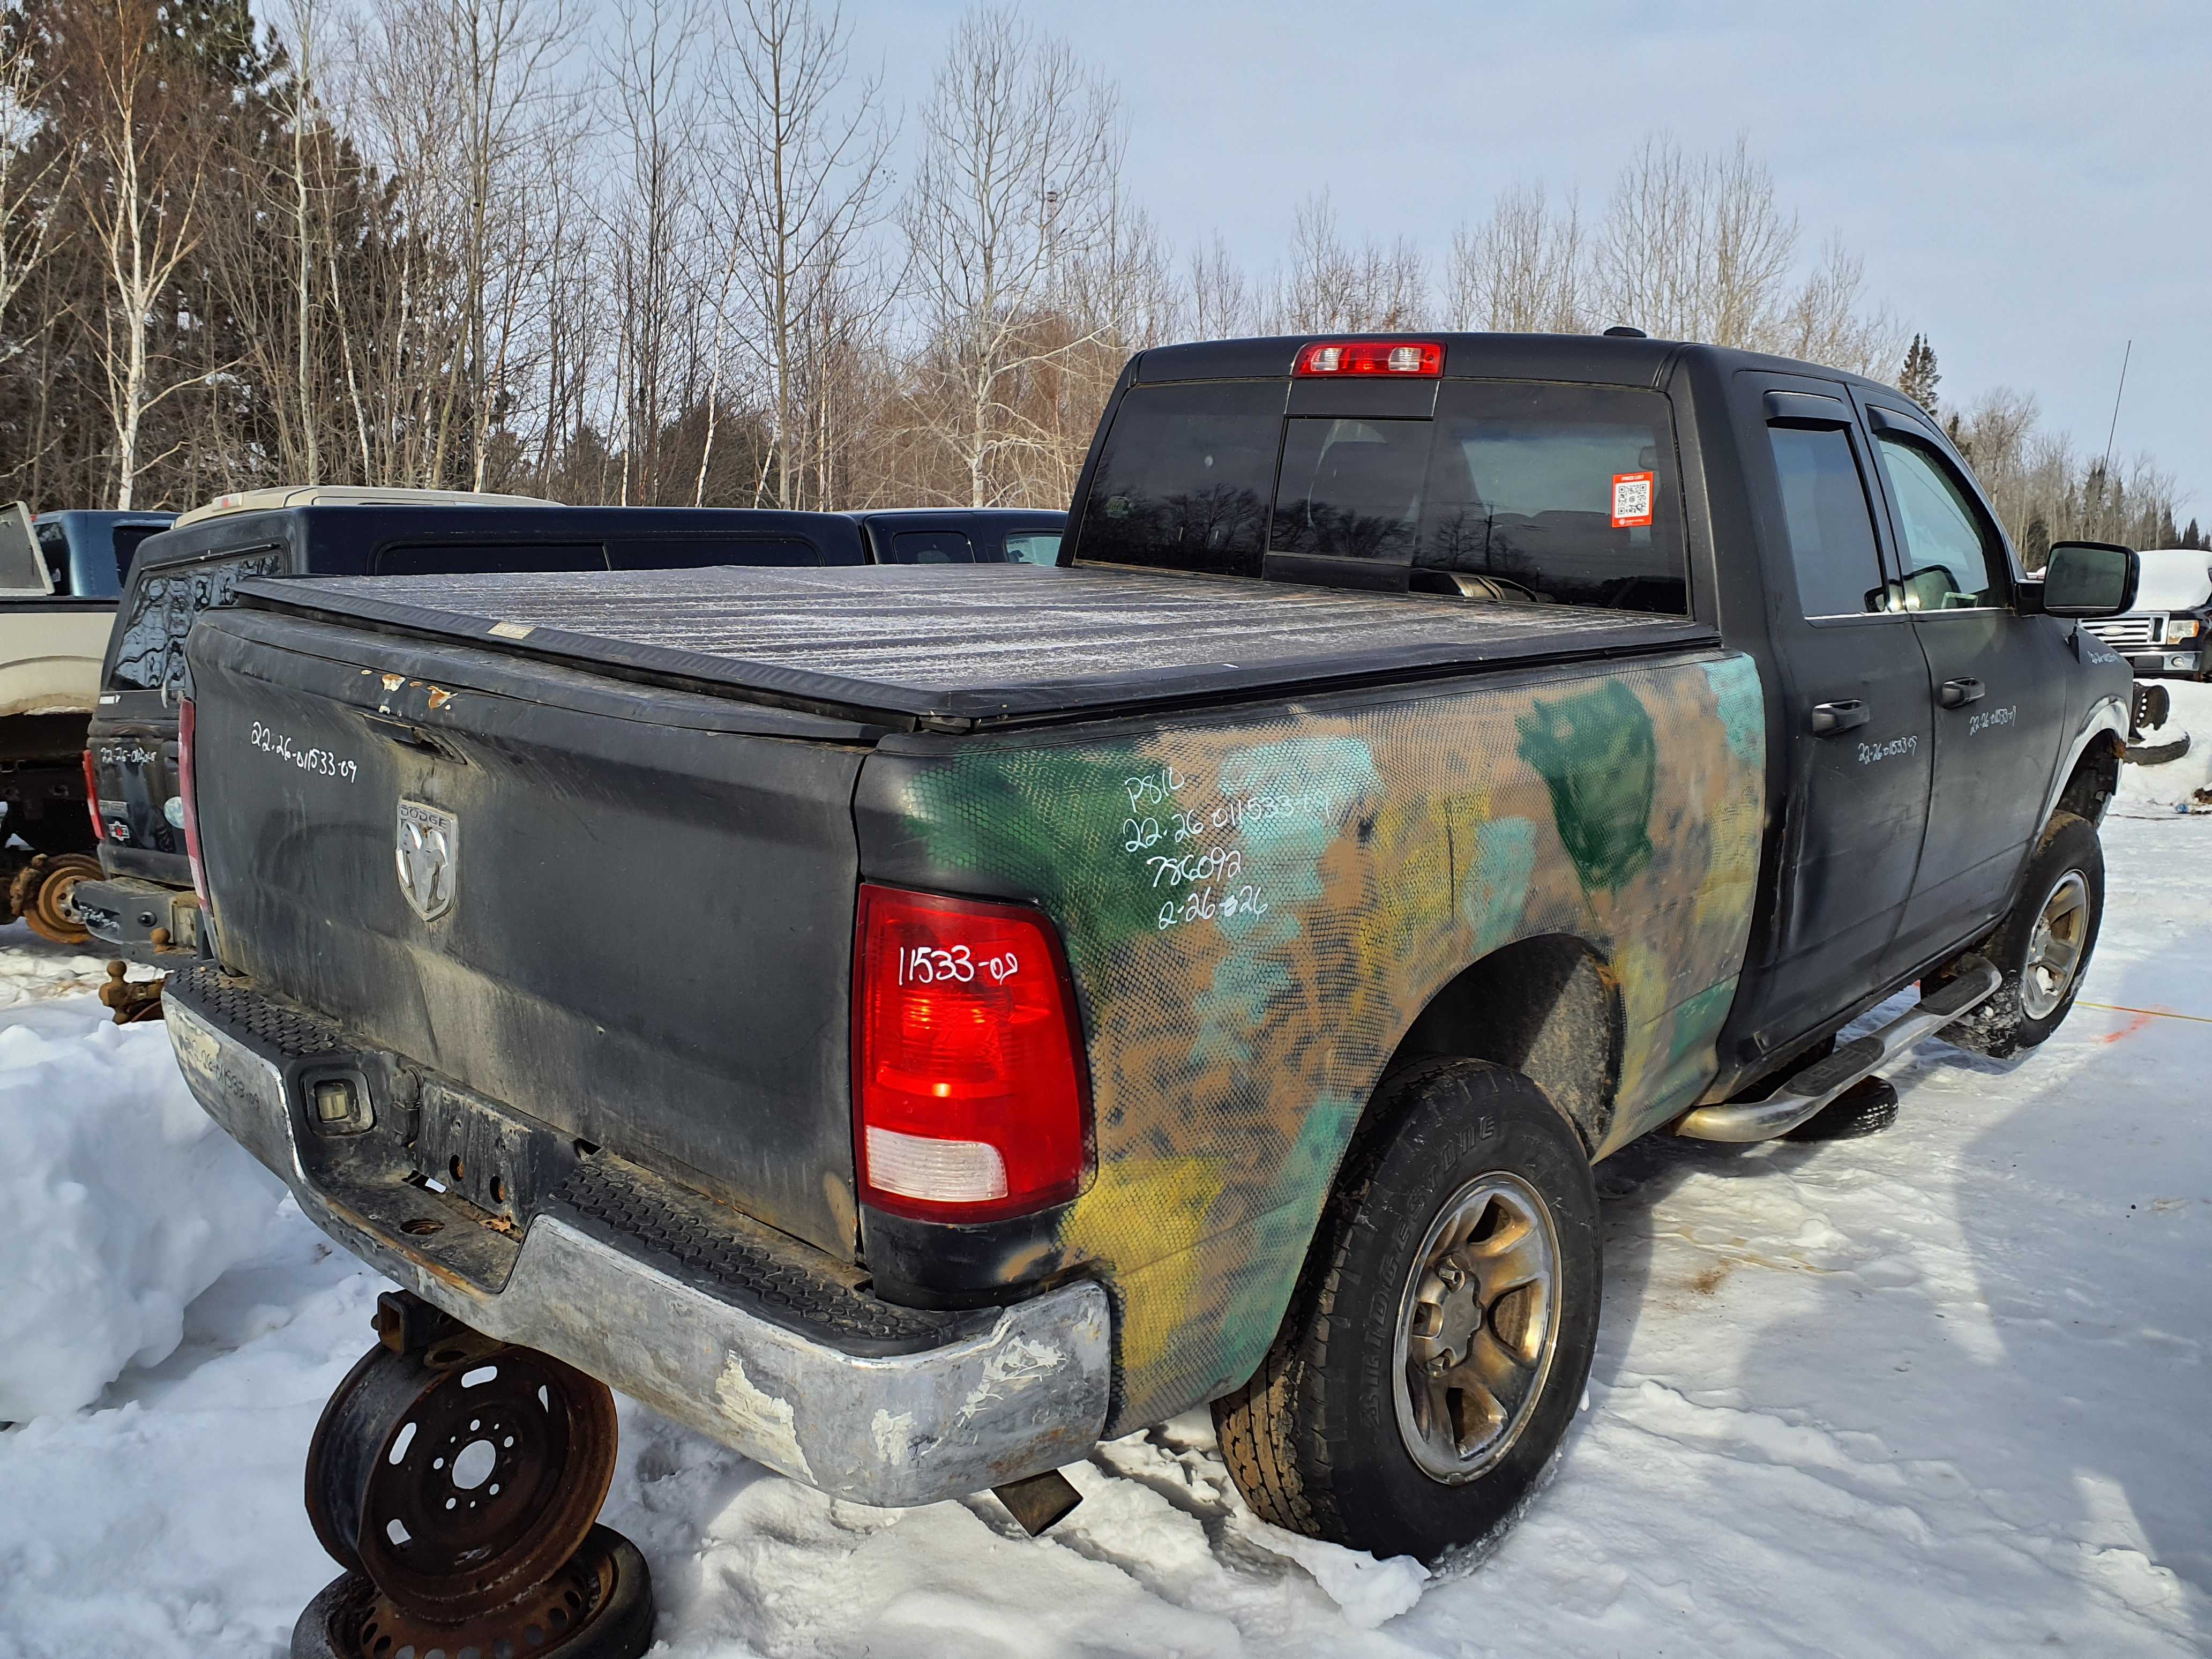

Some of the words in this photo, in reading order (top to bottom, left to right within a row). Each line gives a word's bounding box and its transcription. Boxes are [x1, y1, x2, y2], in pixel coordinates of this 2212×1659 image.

[400, 806, 447, 829] DODGE
[1146, 846, 1241, 888] 786092
[1359, 1116, 1495, 1430] BRIDGESTONE
